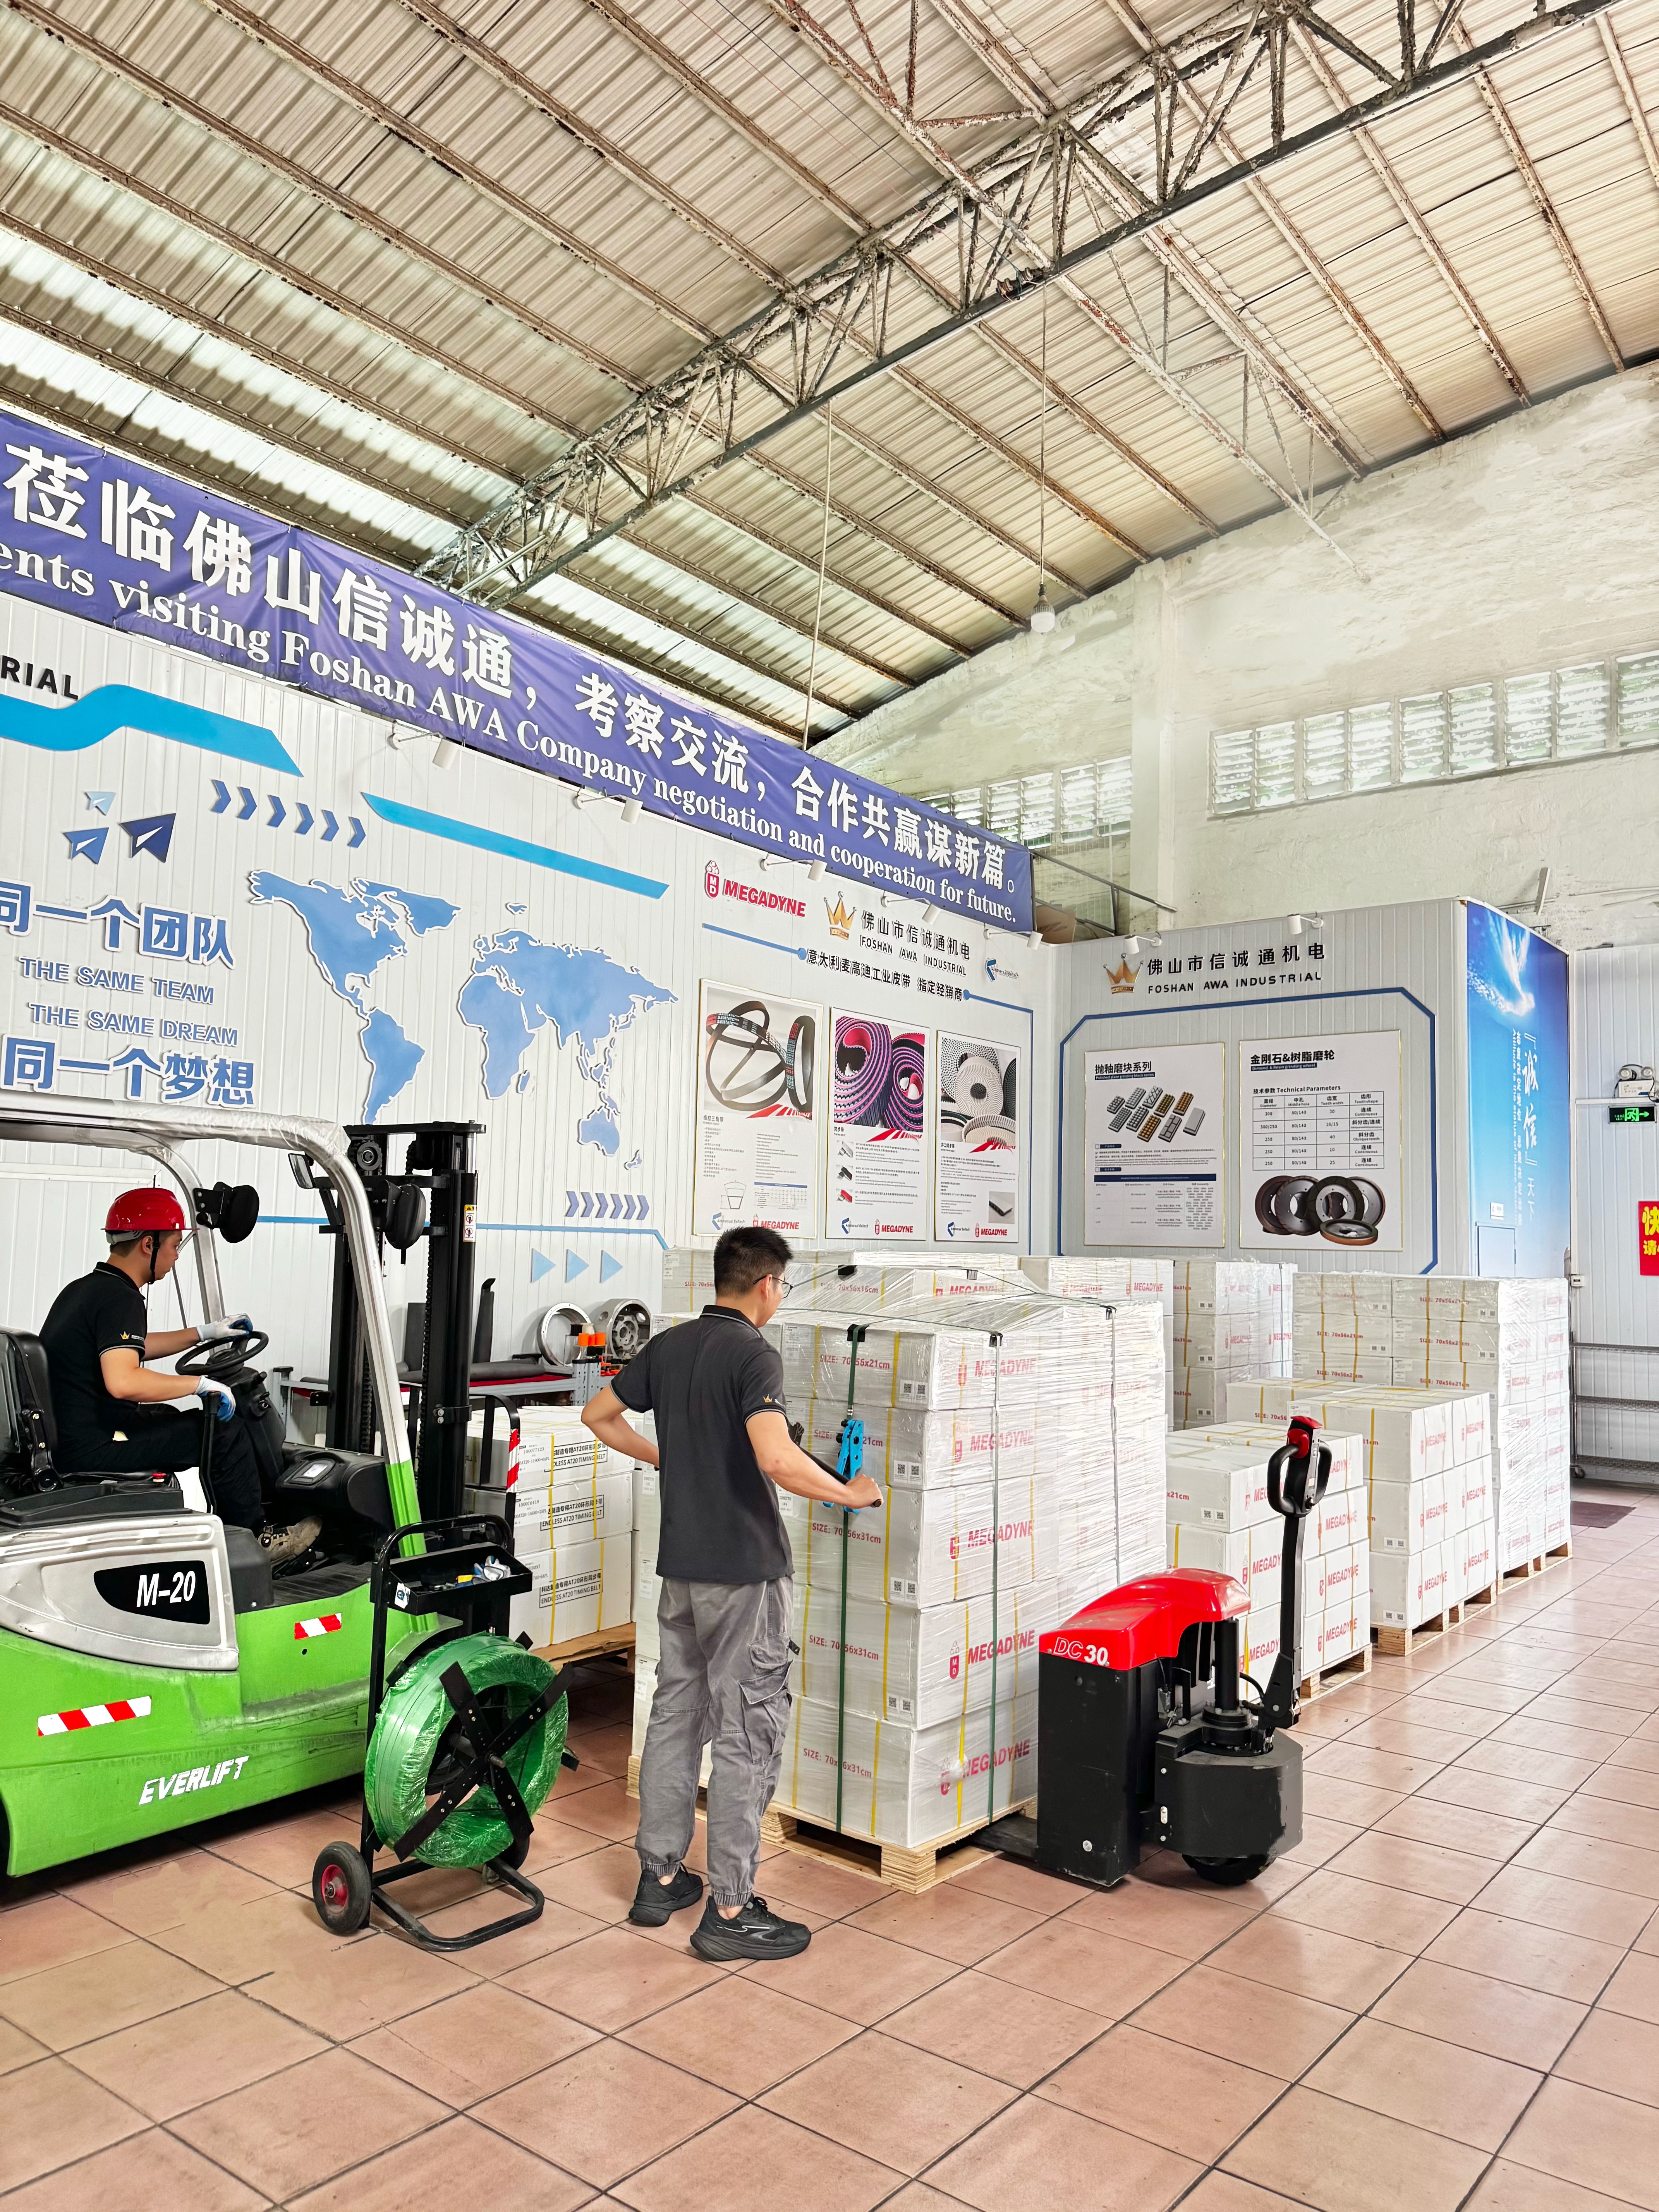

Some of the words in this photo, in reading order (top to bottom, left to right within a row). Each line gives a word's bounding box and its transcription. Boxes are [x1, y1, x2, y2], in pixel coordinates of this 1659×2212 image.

[1, 654, 78, 700] RIAL
[108, 579, 270, 663] visiting
[281, 630, 416, 708] Foshan
[426, 687, 508, 742] AWA
[517, 720, 647, 795] Company
[653, 776, 783, 843] negotiation
[789, 830, 825, 859] and
[831, 844, 936, 896] cooperation
[940, 879, 964, 904] for
[967, 888, 1016, 923] future.
[724, 880, 806, 917] MEGADYNE
[0, 882, 234, 969] 同一个团队
[862, 910, 970, 960] 佛山市信诚通机电
[861, 936, 893, 955] FOSHAN
[901, 946, 917, 962] AWA
[925, 954, 967, 976] INDUSTRIAL
[1148, 943, 1325, 975] 佛山市信诚通机电
[20, 957, 69, 982] THE
[79, 967, 144, 992] SAME
[154, 979, 214, 1004] TEAM
[807, 949, 910, 988] 意大利麦高迪工业皮带
[917, 978, 963, 1001] 指定经销商
[1148, 982, 1194, 994] FOSHAN
[1204, 979, 1228, 990] AWA
[1236, 972, 1322, 987] INDUSTRIAL
[30, 1004, 79, 1026] THE
[89, 1012, 154, 1035] SAME
[163, 1020, 238, 1046] DREAM
[4, 1037, 254, 1105] 同一个梦想
[1095, 1061, 1152, 1074] 抛釉磨块系列
[1250, 1050, 1334, 1065] 金刚石&树脂磨轮
[761, 1220, 799, 1230] MEGADYNE
[882, 1225, 913, 1233] MEGADYNE
[1643, 1240, 1659, 1255] 请
[1134, 1282, 1163, 1292] MEGADYNE
[820, 1355, 839, 1365] SIZE:
[842, 1356, 890, 1370] 7056x21cm
[814, 1430, 833, 1439] SIZE:
[575, 1512, 591, 1520] TIMING
[812, 1523, 831, 1534] SIZE:
[834, 1525, 881, 1544] 7056x31cm
[1252, 1553, 1281, 1575] MEGADY
[137, 1570, 196, 1608] M-20
[574, 1587, 590, 1595] TIMING
[809, 1634, 828, 1647] SIZE:
[831, 1640, 879, 1661] 7056x31cm
[968, 1630, 1036, 1665] MEGADYNE
[1053, 1637, 1083, 1659] DC
[1084, 1644, 1109, 1666] 30
[1249, 1638, 1280, 1662] MEGADY
[803, 1748, 822, 1762] SIZE:
[825, 1754, 872, 1778] 70x6x31cm
[139, 1756, 249, 1805] EVERLIFT
